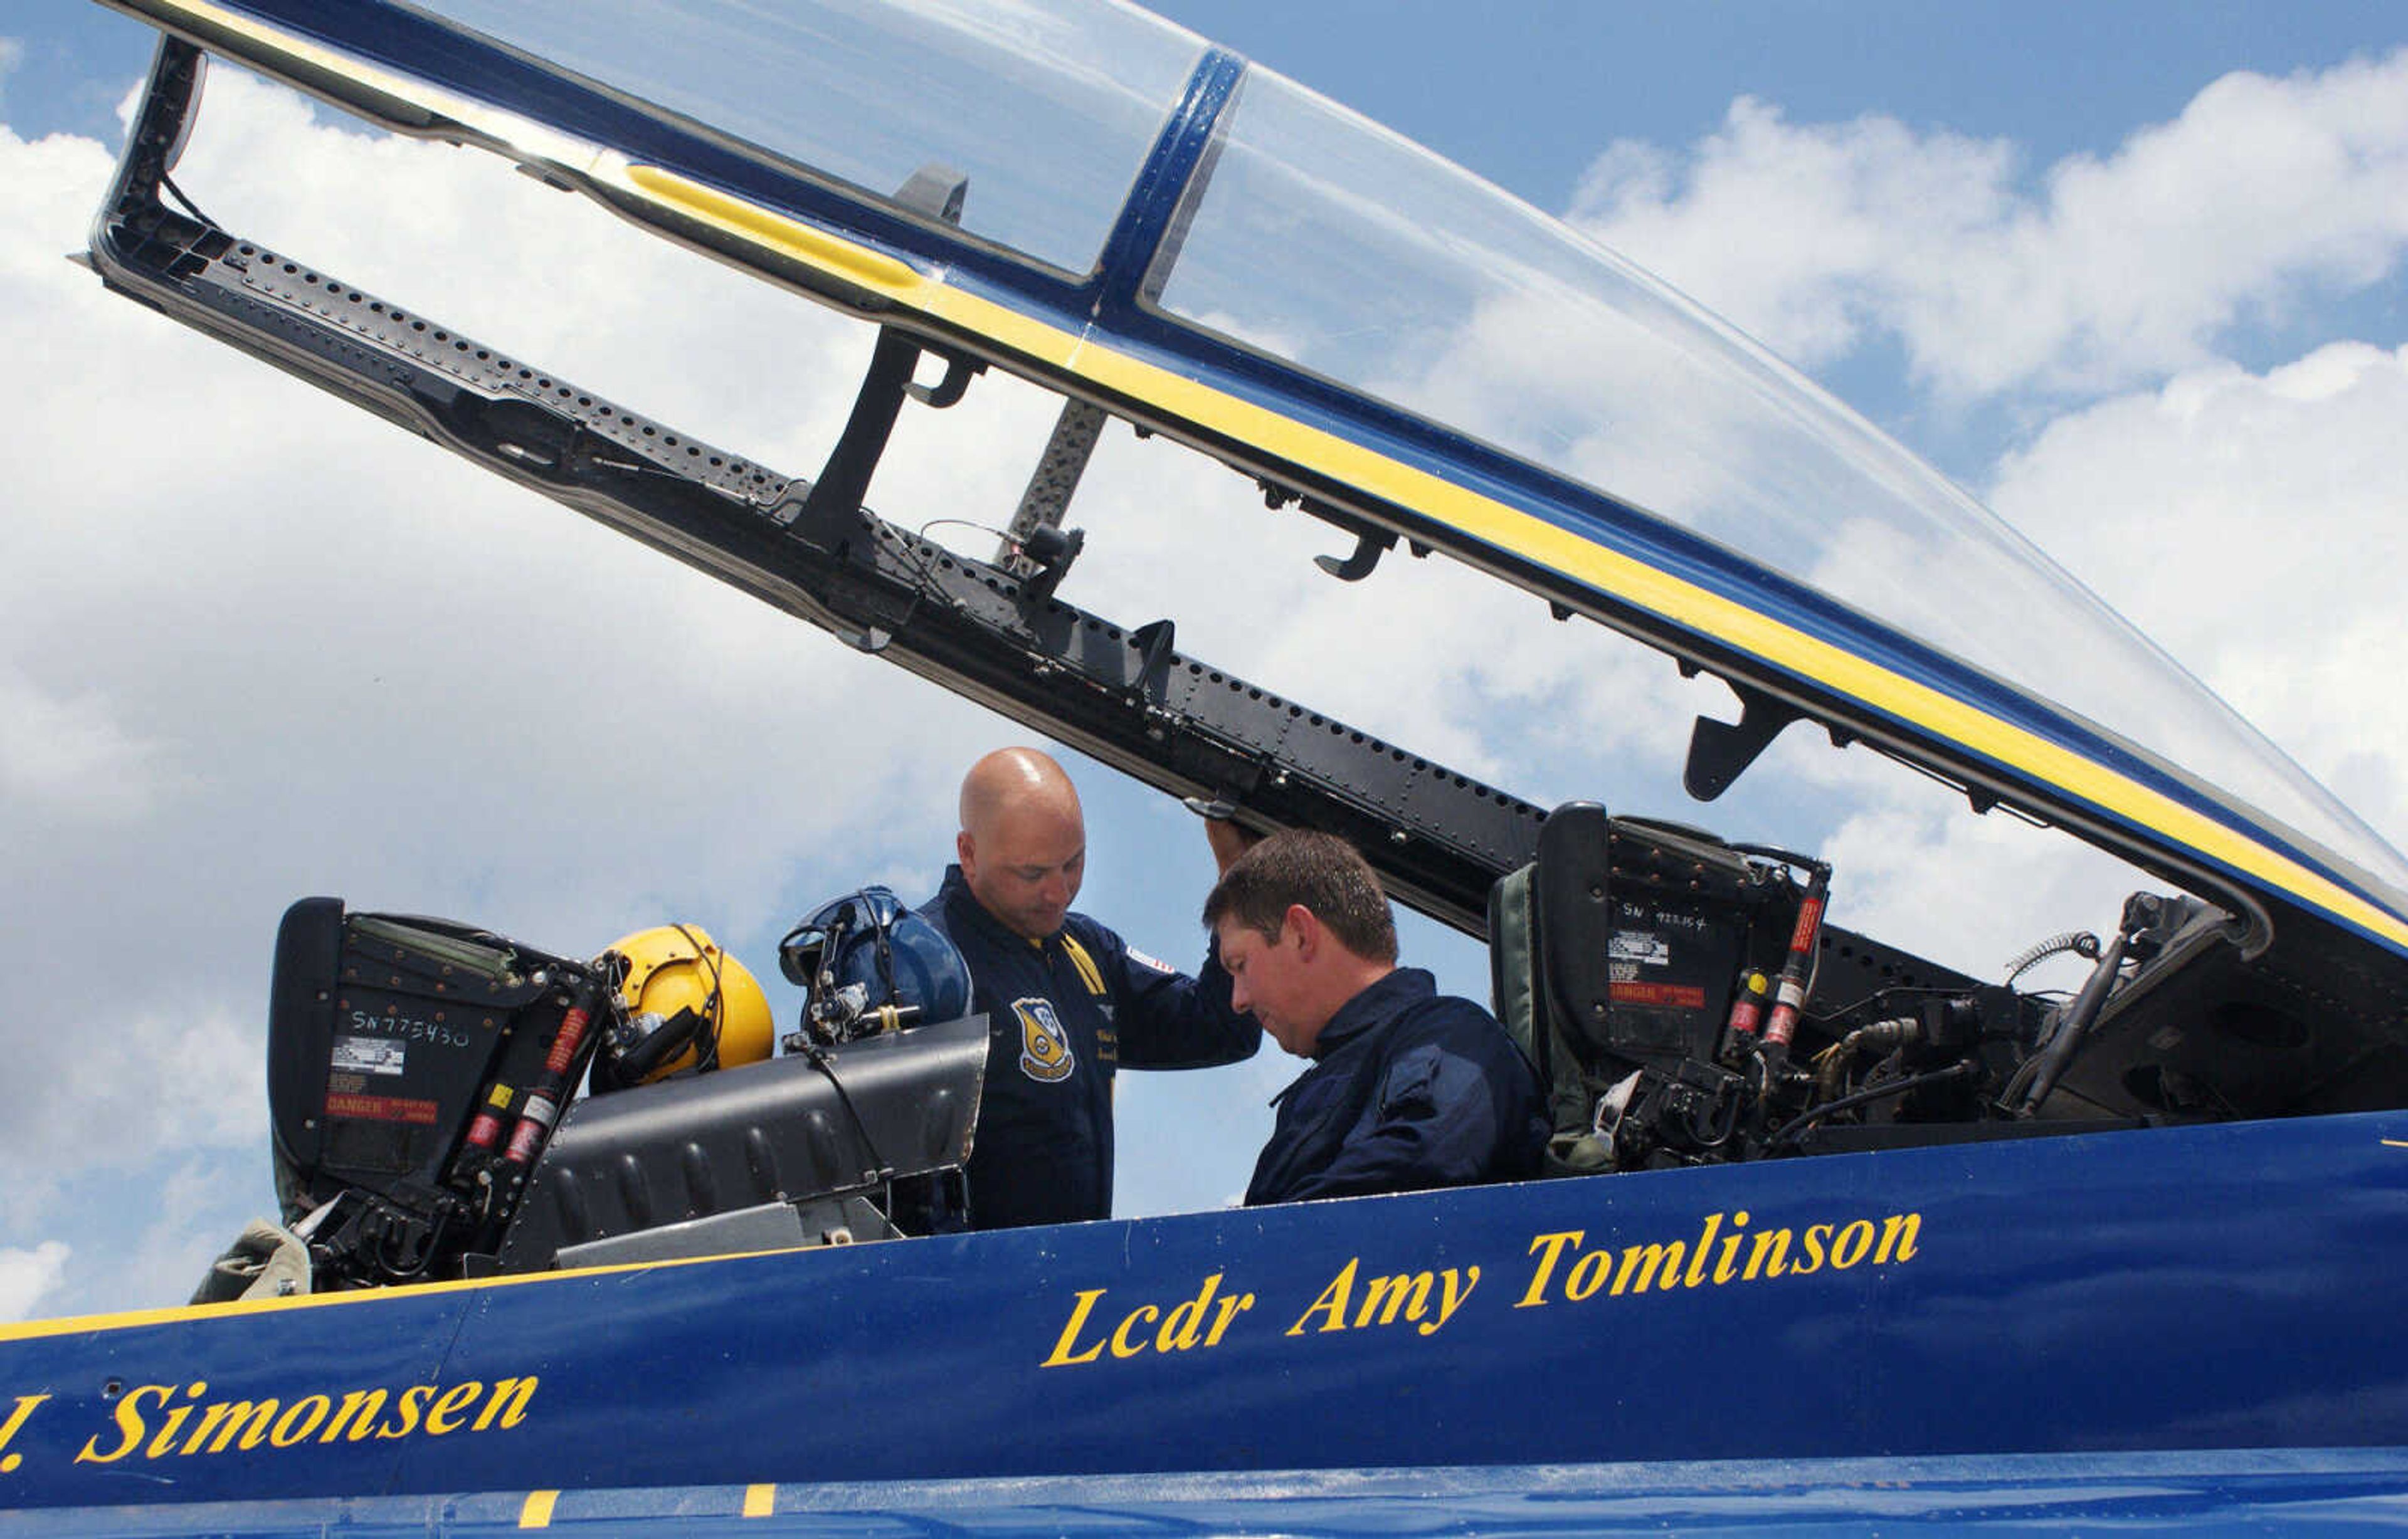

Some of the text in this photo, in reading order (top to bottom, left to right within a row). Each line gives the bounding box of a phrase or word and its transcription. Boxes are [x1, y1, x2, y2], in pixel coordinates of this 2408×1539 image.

[327, 1096, 382, 1115] DANGER
[1040, 1211, 1923, 1368] Lcdr Amy Tomlinson
[73, 1375, 539, 1464] Simonsen
